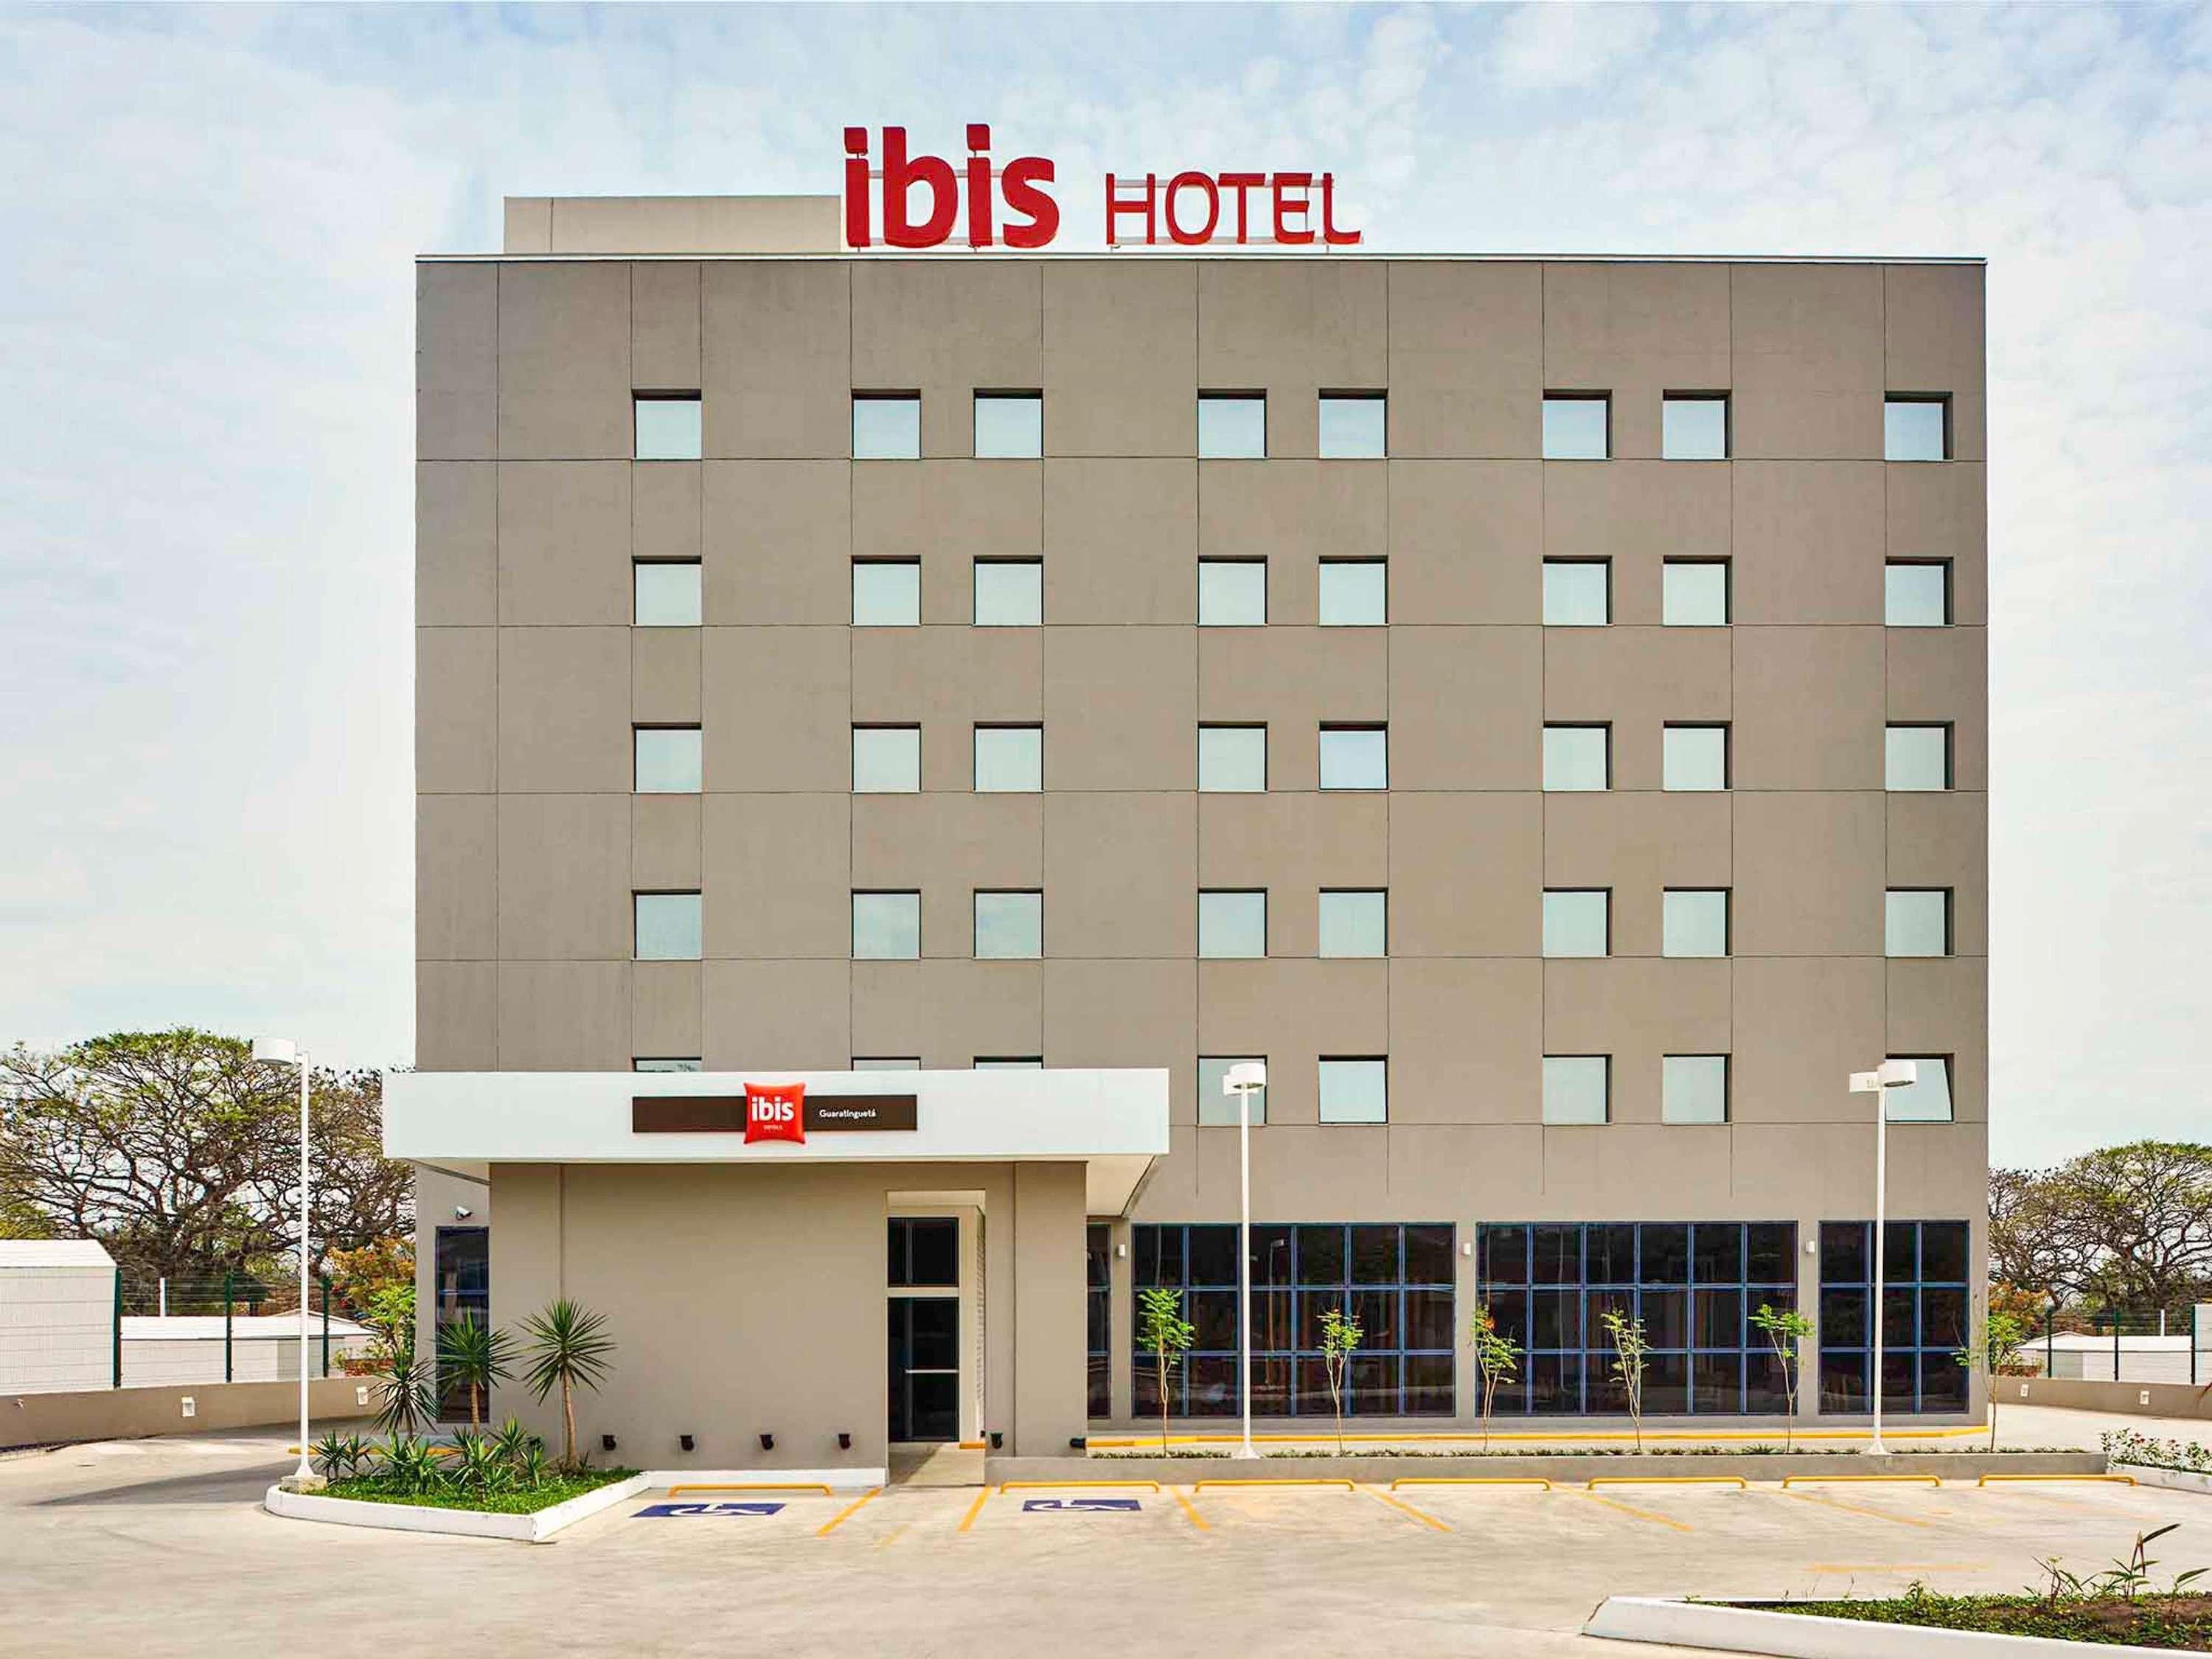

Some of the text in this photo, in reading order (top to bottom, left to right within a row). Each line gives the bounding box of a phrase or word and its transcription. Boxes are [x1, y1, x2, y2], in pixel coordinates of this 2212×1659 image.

[844, 124, 1362, 248] ibis HOTEL
[752, 1096, 794, 1121] ibis
[819, 1108, 876, 1119] Guaratinguetá
